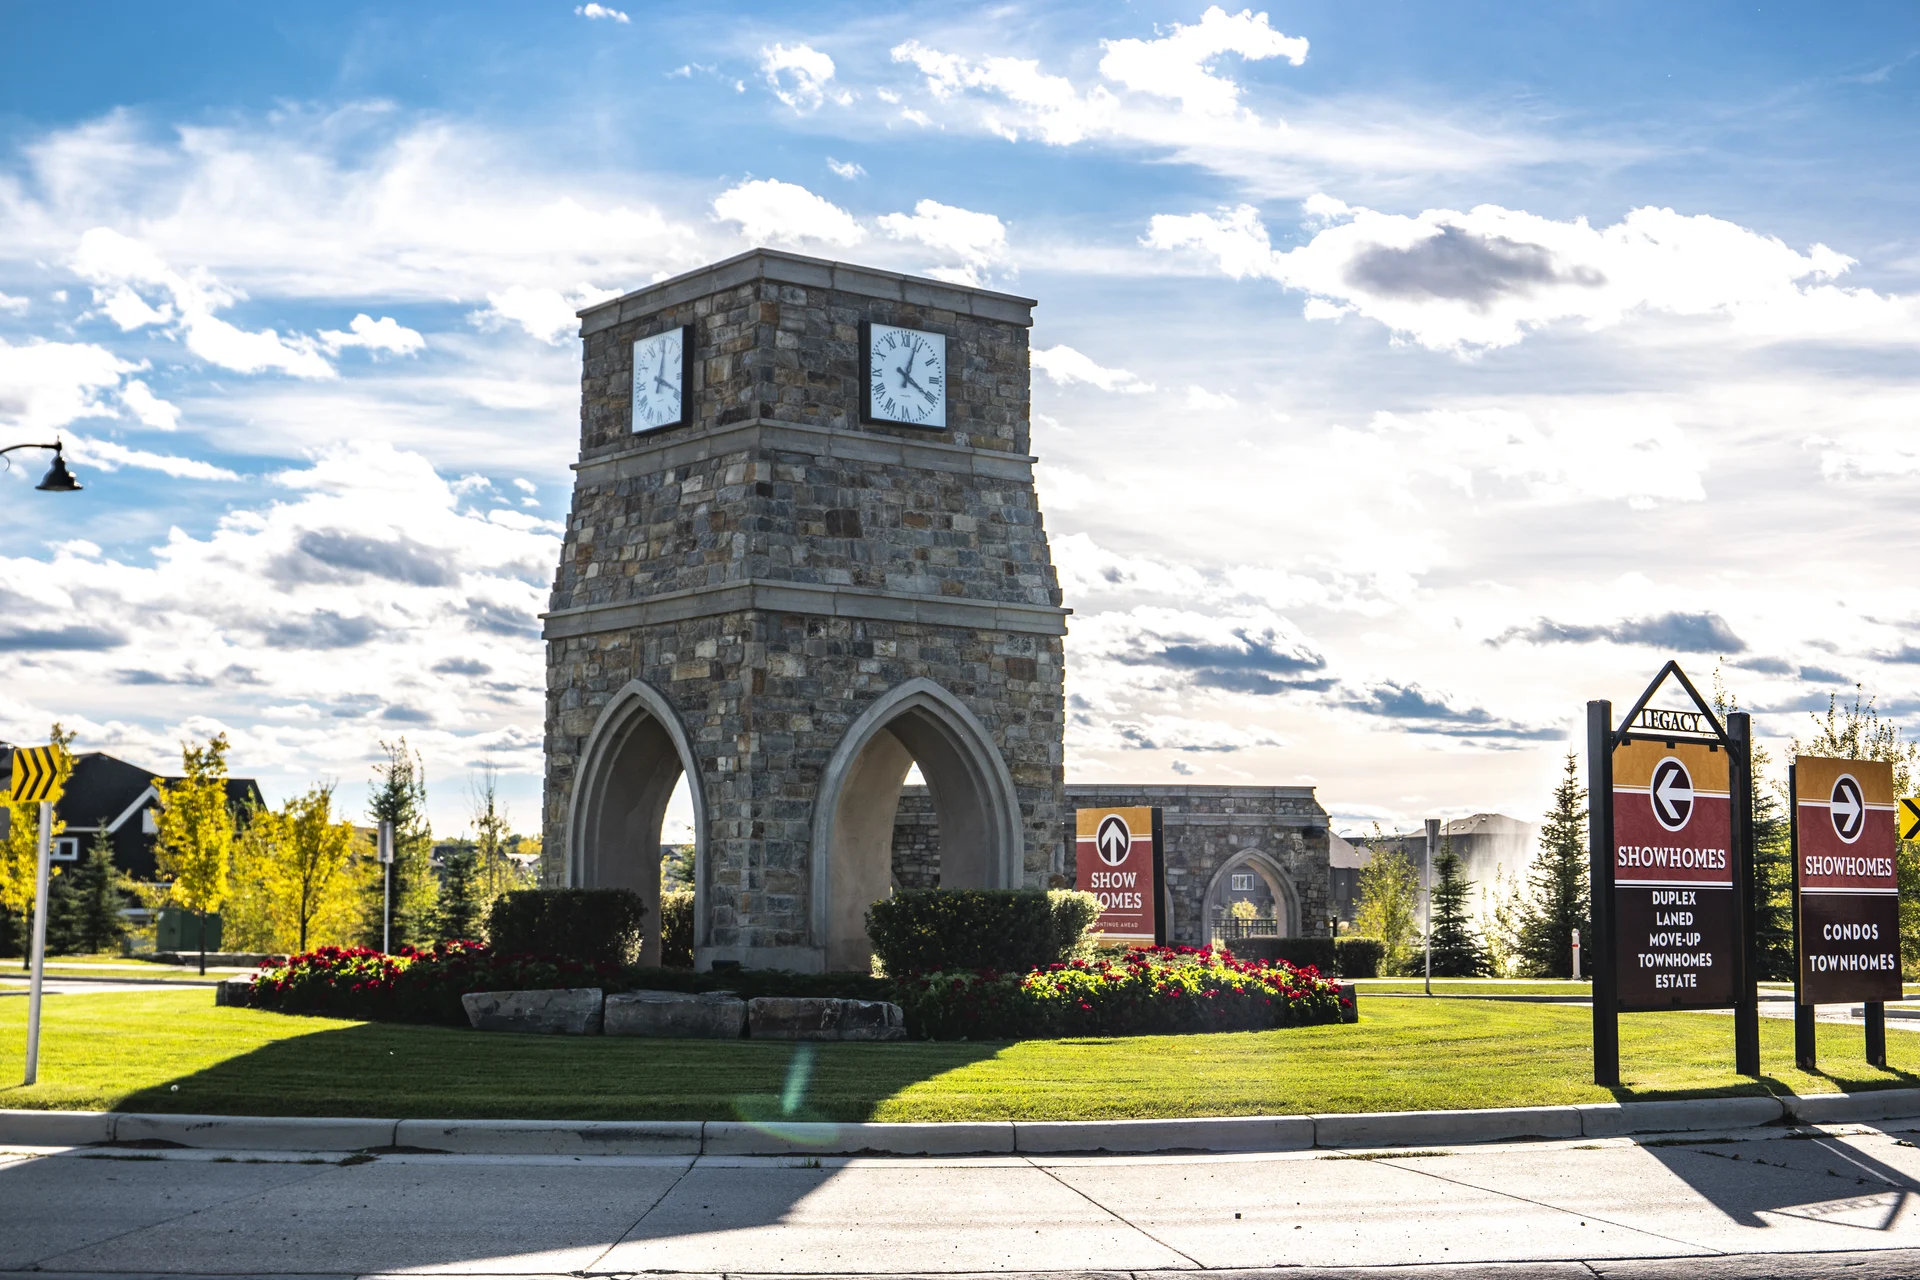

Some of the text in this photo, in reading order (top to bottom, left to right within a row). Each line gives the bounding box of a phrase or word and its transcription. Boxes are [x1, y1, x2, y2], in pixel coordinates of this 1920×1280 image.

[1641, 709, 1701, 732] LEGACY
[1617, 845, 1726, 870] SHOWHOMES
[1805, 855, 1892, 877] SHOWHOMES
[1091, 872, 1137, 888] SHOW
[1094, 892, 1142, 909] OMES
[1652, 890, 1697, 905] DUPLEX
[1656, 911, 1694, 926] LANED
[1649, 932, 1701, 947] MOVE-UP
[1823, 923, 1879, 941] CONDOS
[1637, 952, 1713, 968] TOWNHOMES
[1809, 953, 1895, 972] TOWNHOMES
[1655, 973, 1697, 989] ESTATE
